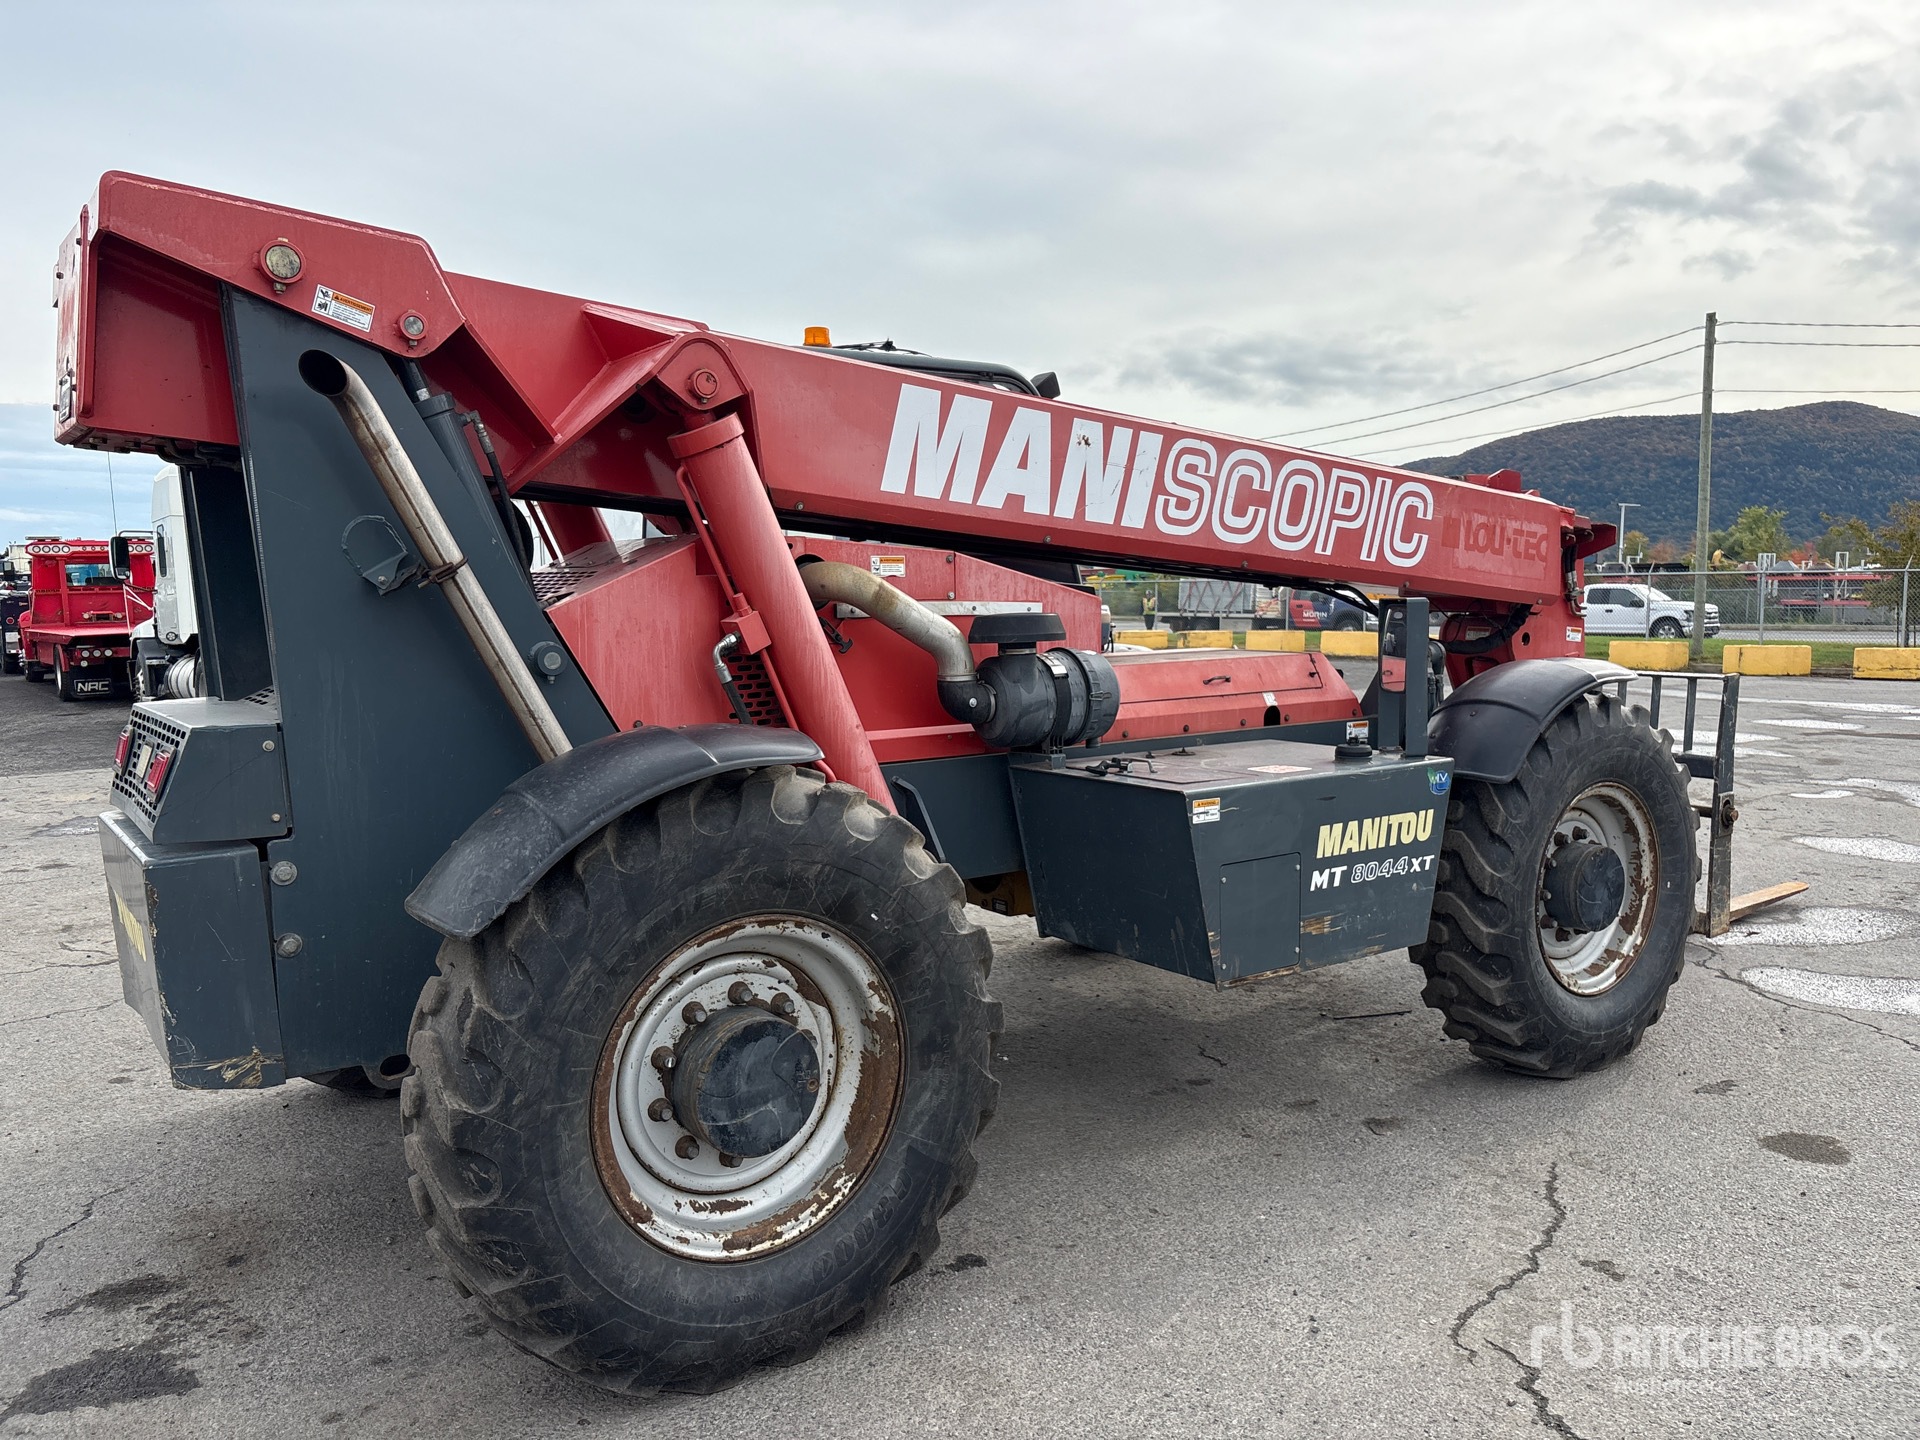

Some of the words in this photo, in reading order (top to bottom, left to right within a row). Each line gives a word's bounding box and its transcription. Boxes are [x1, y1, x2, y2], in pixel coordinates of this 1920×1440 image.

[880, 382, 1434, 568] MANISCOPIC
[77, 681, 109, 692] NRC
[1316, 808, 1435, 859] MANITOU
[1310, 865, 1348, 892] MT
